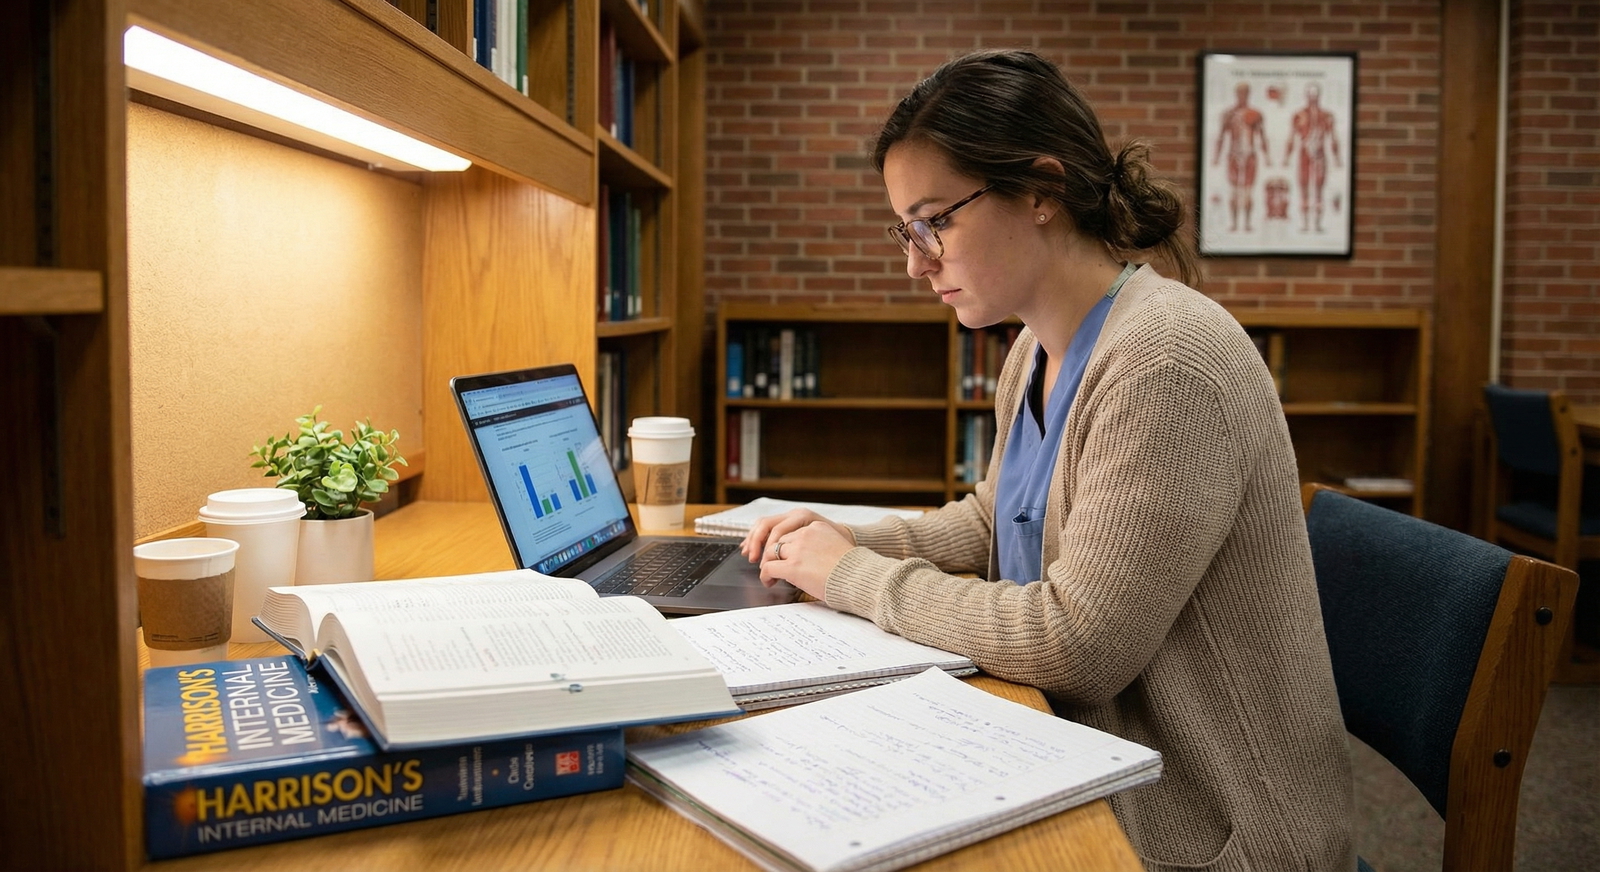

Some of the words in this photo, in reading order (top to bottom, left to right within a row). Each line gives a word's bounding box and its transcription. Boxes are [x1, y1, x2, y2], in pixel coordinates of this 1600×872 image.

[178, 668, 229, 758] HARRISON'S
[222, 664, 274, 750] INTERNAL
[259, 661, 316, 745] MEDICINE
[197, 759, 424, 822] HARRISON'S
[198, 812, 311, 843] INTERNAL
[317, 794, 424, 825] MEDICINE
